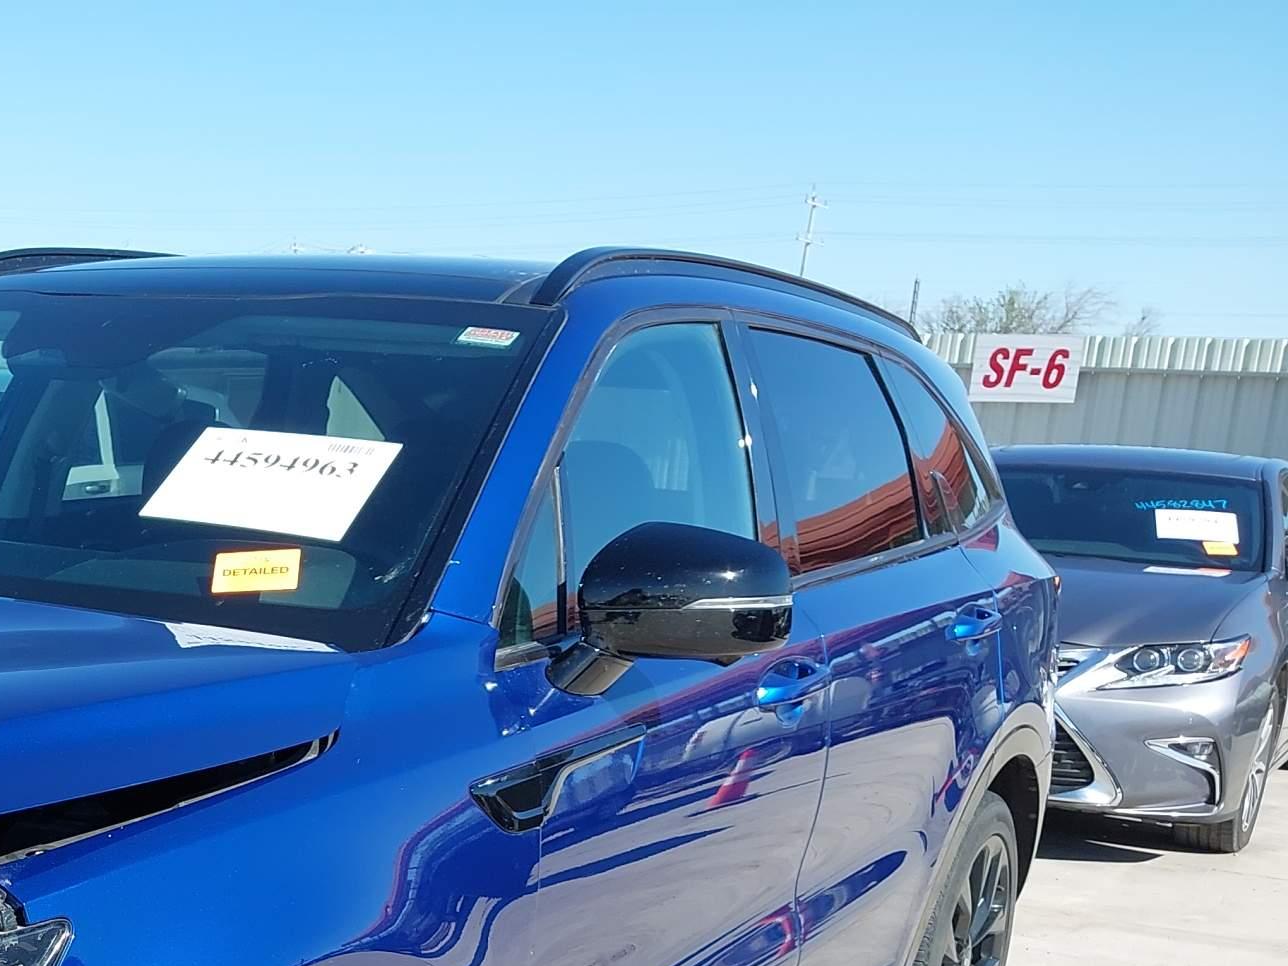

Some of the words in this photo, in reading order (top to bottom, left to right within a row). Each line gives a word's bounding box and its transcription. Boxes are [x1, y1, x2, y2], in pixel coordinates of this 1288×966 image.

[982, 347, 1070, 389] SF-6
[205, 449, 359, 478] 44594963
[222, 566, 289, 577] DETAILED
